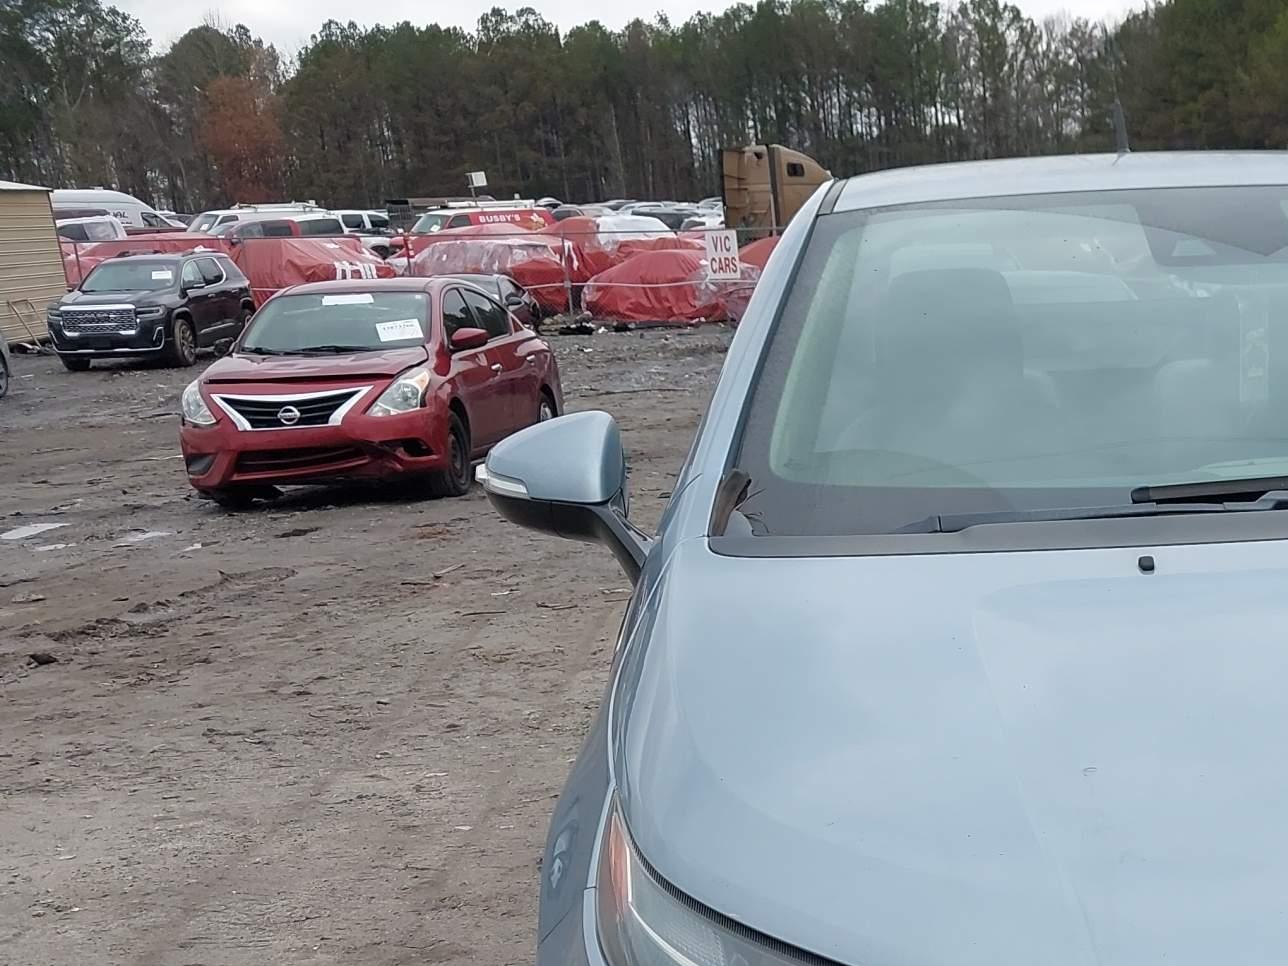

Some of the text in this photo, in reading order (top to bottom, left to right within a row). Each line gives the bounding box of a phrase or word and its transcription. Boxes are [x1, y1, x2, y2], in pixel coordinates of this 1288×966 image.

[478, 213, 521, 223] BUSBY'S
[711, 235, 732, 253] VIC
[710, 256, 738, 274] CARS
